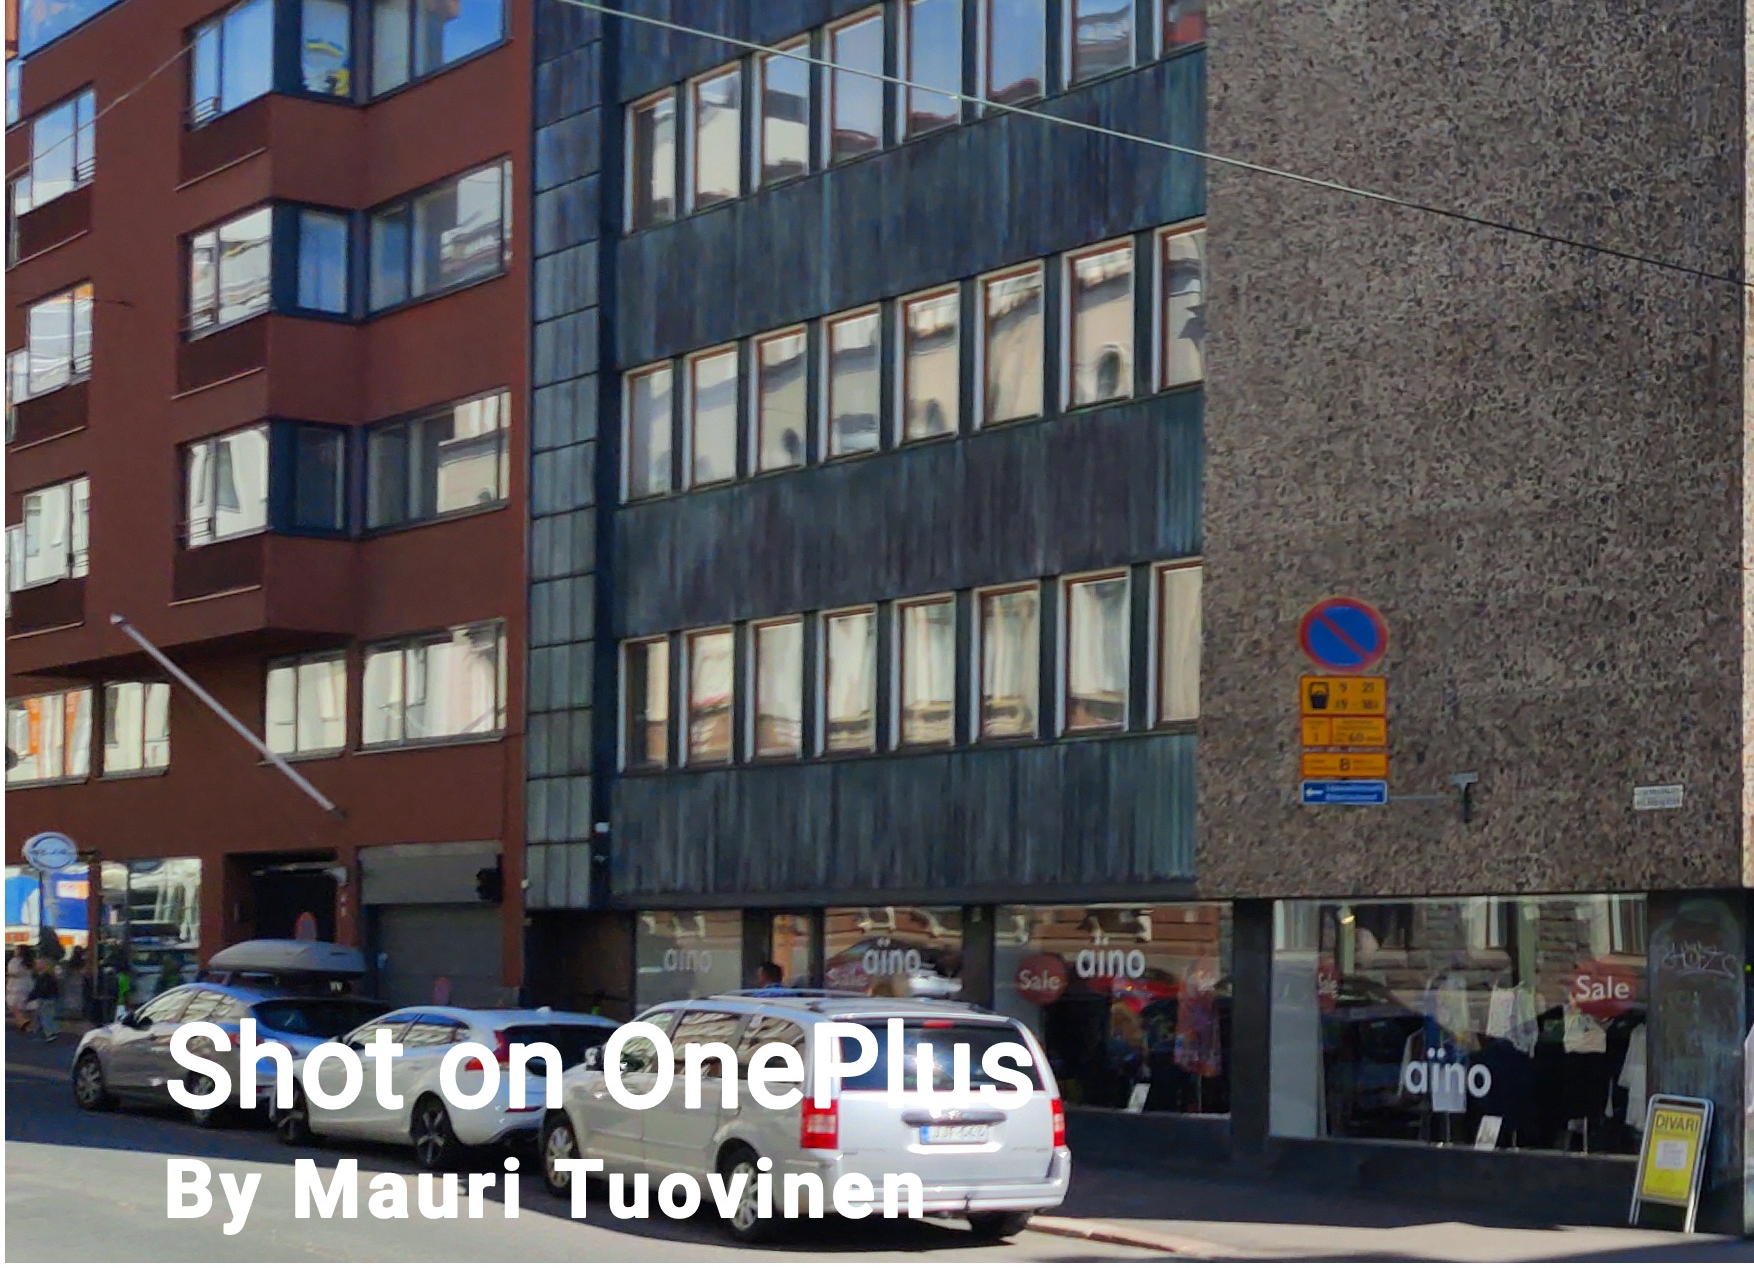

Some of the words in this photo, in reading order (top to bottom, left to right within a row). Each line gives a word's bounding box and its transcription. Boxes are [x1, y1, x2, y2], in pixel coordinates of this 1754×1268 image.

[1019, 969, 1061, 991] Sale
[1575, 975, 1629, 1001] Sale
[1655, 1113, 1699, 1132] DIVARI
